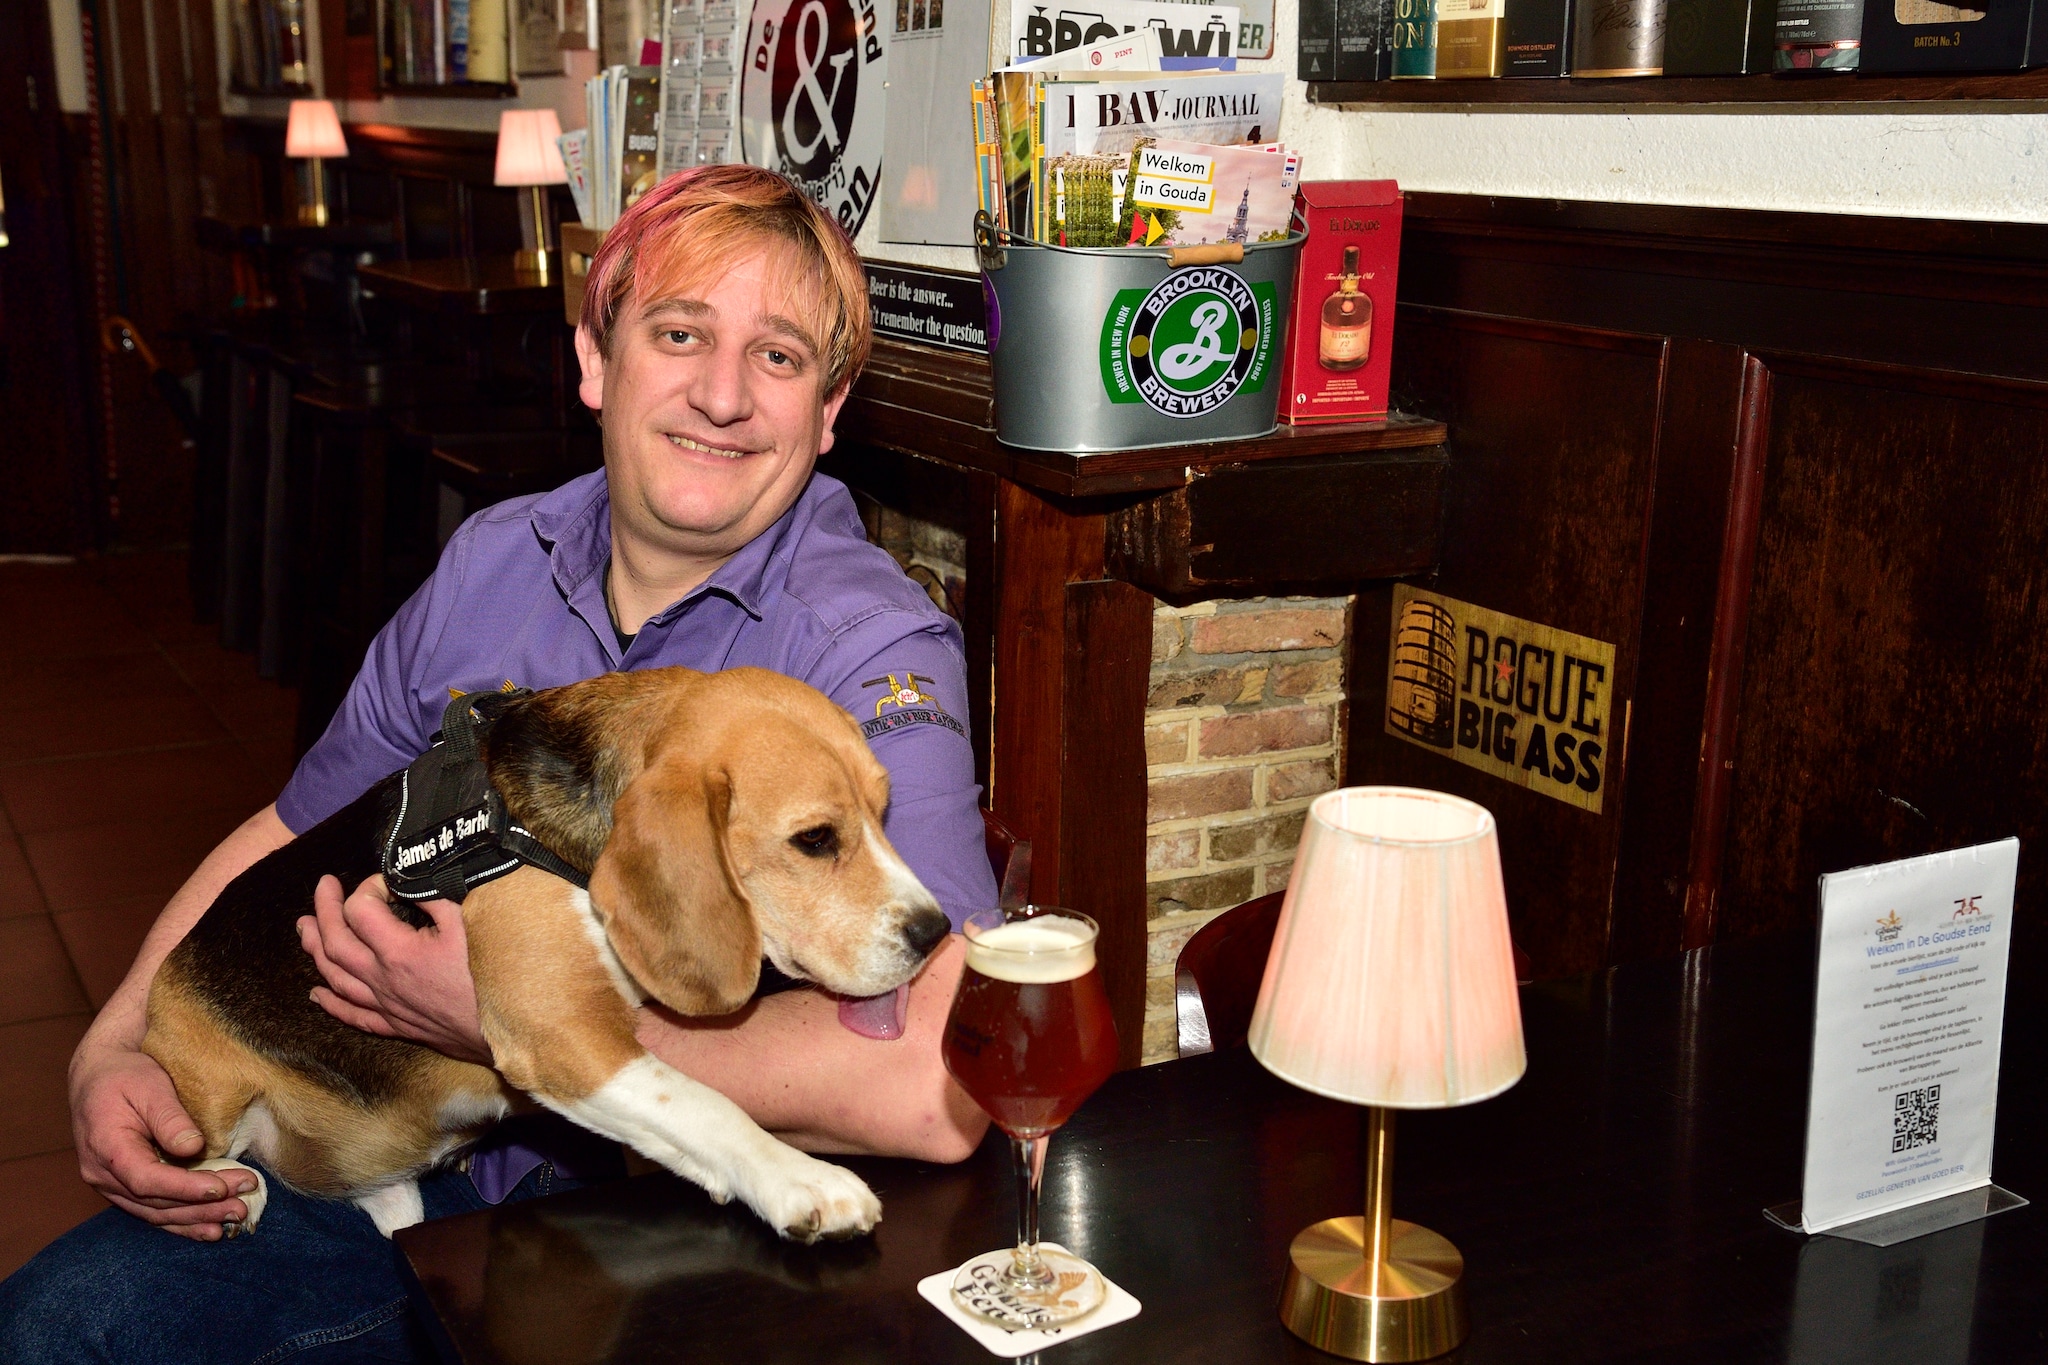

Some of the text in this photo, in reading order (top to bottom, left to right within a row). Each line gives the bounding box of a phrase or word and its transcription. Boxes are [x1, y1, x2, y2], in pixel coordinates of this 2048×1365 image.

[755, 20, 774, 72] De
[1115, 47, 1133, 59] PINT
[1530, 43, 1556, 51] DISTILLERY
[1914, 31, 1960, 47] BATCH No. 3
[1172, 93, 1260, 121] JOURNAAL
[1247, 125, 1261, 144] 4
[1145, 153, 1206, 176] Welkom
[1140, 179, 1154, 196] in
[1159, 182, 1207, 202] Gouda
[870, 276, 953, 308] Beer is the answer...
[1146, 271, 1251, 316] BROOKLYN
[880, 311, 987, 345] remember the question.
[1251, 298, 1272, 381] ESTABLISHED IN 1988
[1111, 305, 1131, 393] BREWED IN NEW YORK
[1141, 369, 1240, 413] BREWERY
[1462, 625, 1604, 736] ROGUE
[889, 712, 912, 730] VAN
[1457, 699, 1602, 793] BIG ASS
[395, 837, 437, 871] James
[438, 826, 454, 852] de
[1867, 922, 1991, 958] Welkom in De Goudse Eend
[1876, 925, 1903, 936] Goudse
[1879, 931, 1898, 942] Eend
[1856, 1164, 1964, 1200] GEZELLIG GENIETEN VAN GOED BIER
